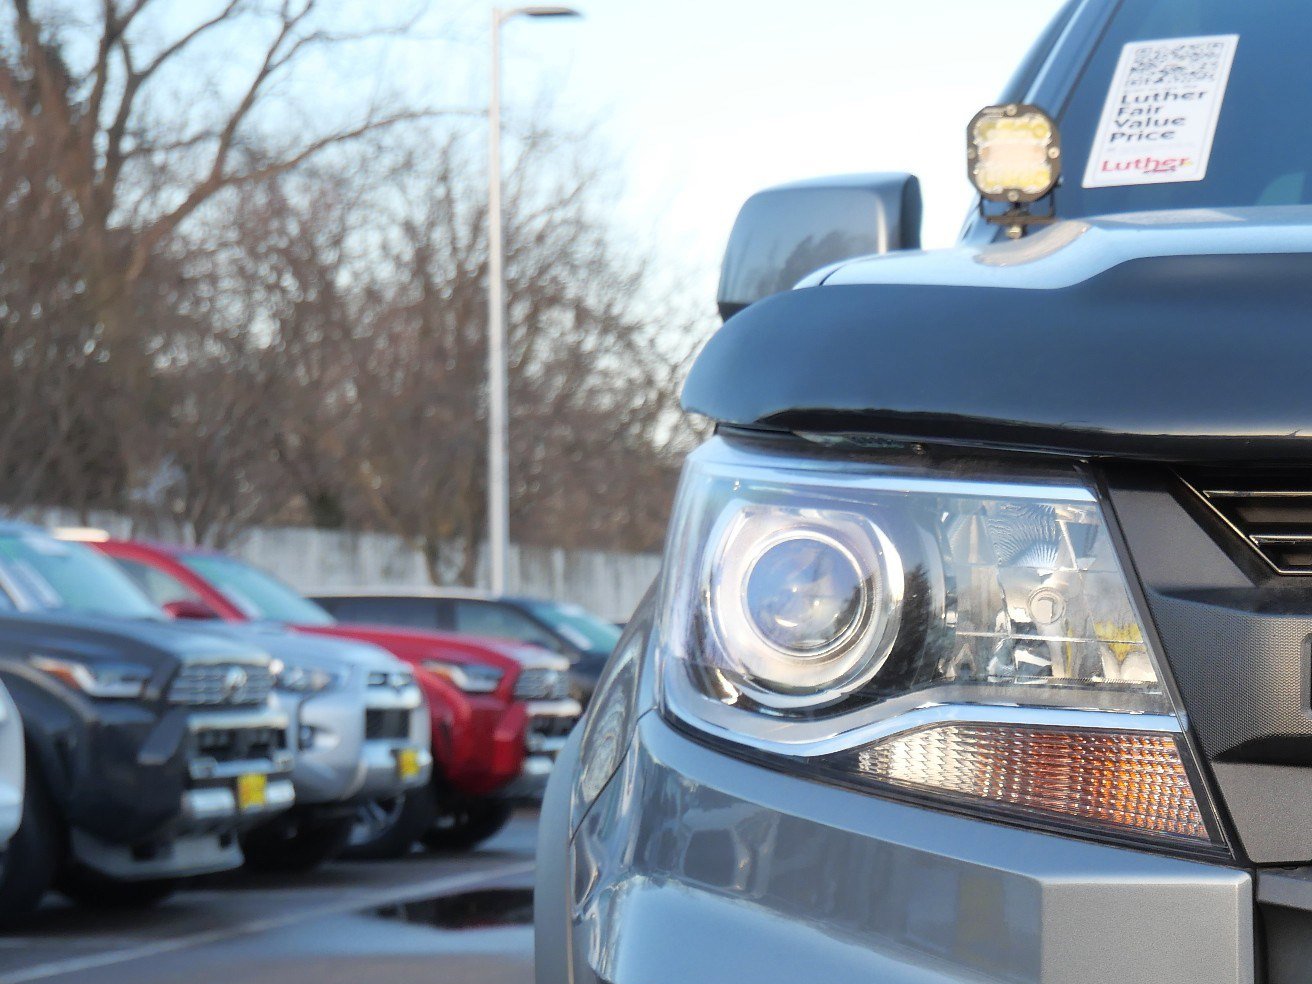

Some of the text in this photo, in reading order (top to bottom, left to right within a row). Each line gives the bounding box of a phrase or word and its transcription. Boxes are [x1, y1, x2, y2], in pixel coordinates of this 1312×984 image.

[1120, 91, 1208, 104] Luther
[1116, 105, 1163, 117] Fair
[1113, 117, 1187, 130] Value
[1109, 130, 1176, 143] Price
[1101, 157, 1190, 173] Luther
